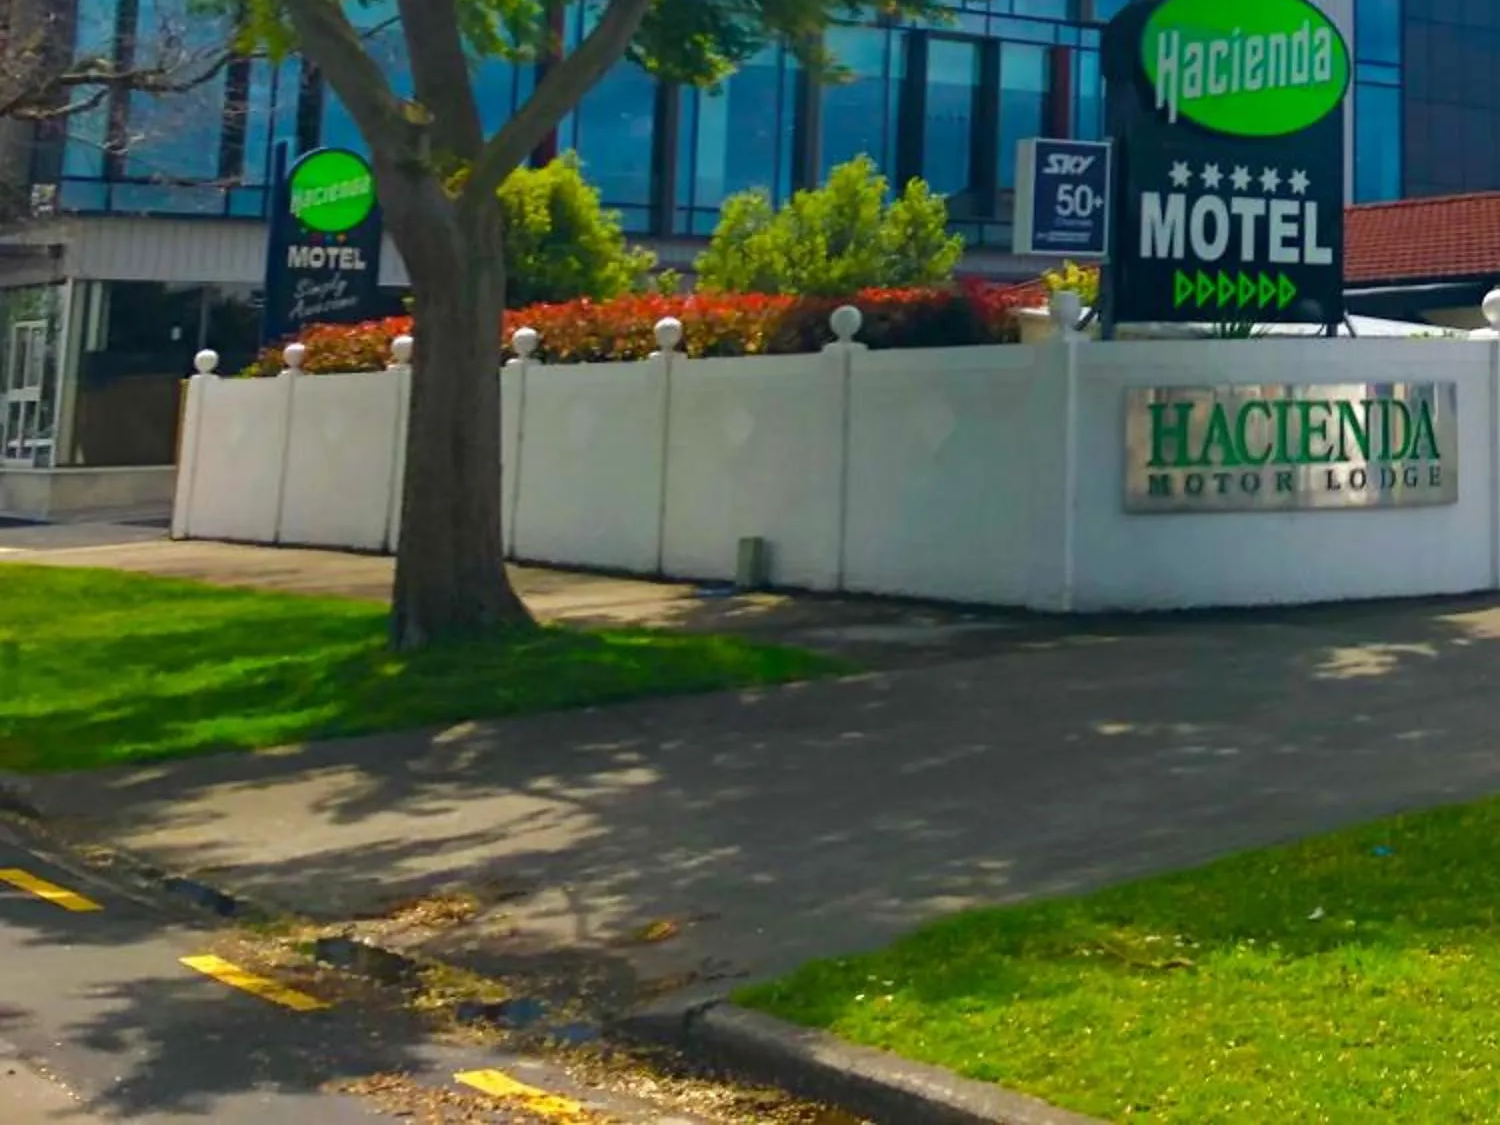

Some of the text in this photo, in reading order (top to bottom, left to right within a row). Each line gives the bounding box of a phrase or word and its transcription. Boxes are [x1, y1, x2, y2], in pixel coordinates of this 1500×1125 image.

[1156, 19, 1331, 123] Hacienda
[1042, 153, 1095, 174] SKY
[1056, 183, 1103, 217] 50+
[1140, 191, 1333, 264] MOTEL
[287, 245, 367, 270] MOTEL
[1146, 399, 1441, 468] HACIENDA
[1147, 466, 1441, 496] MOTOR LODGE
